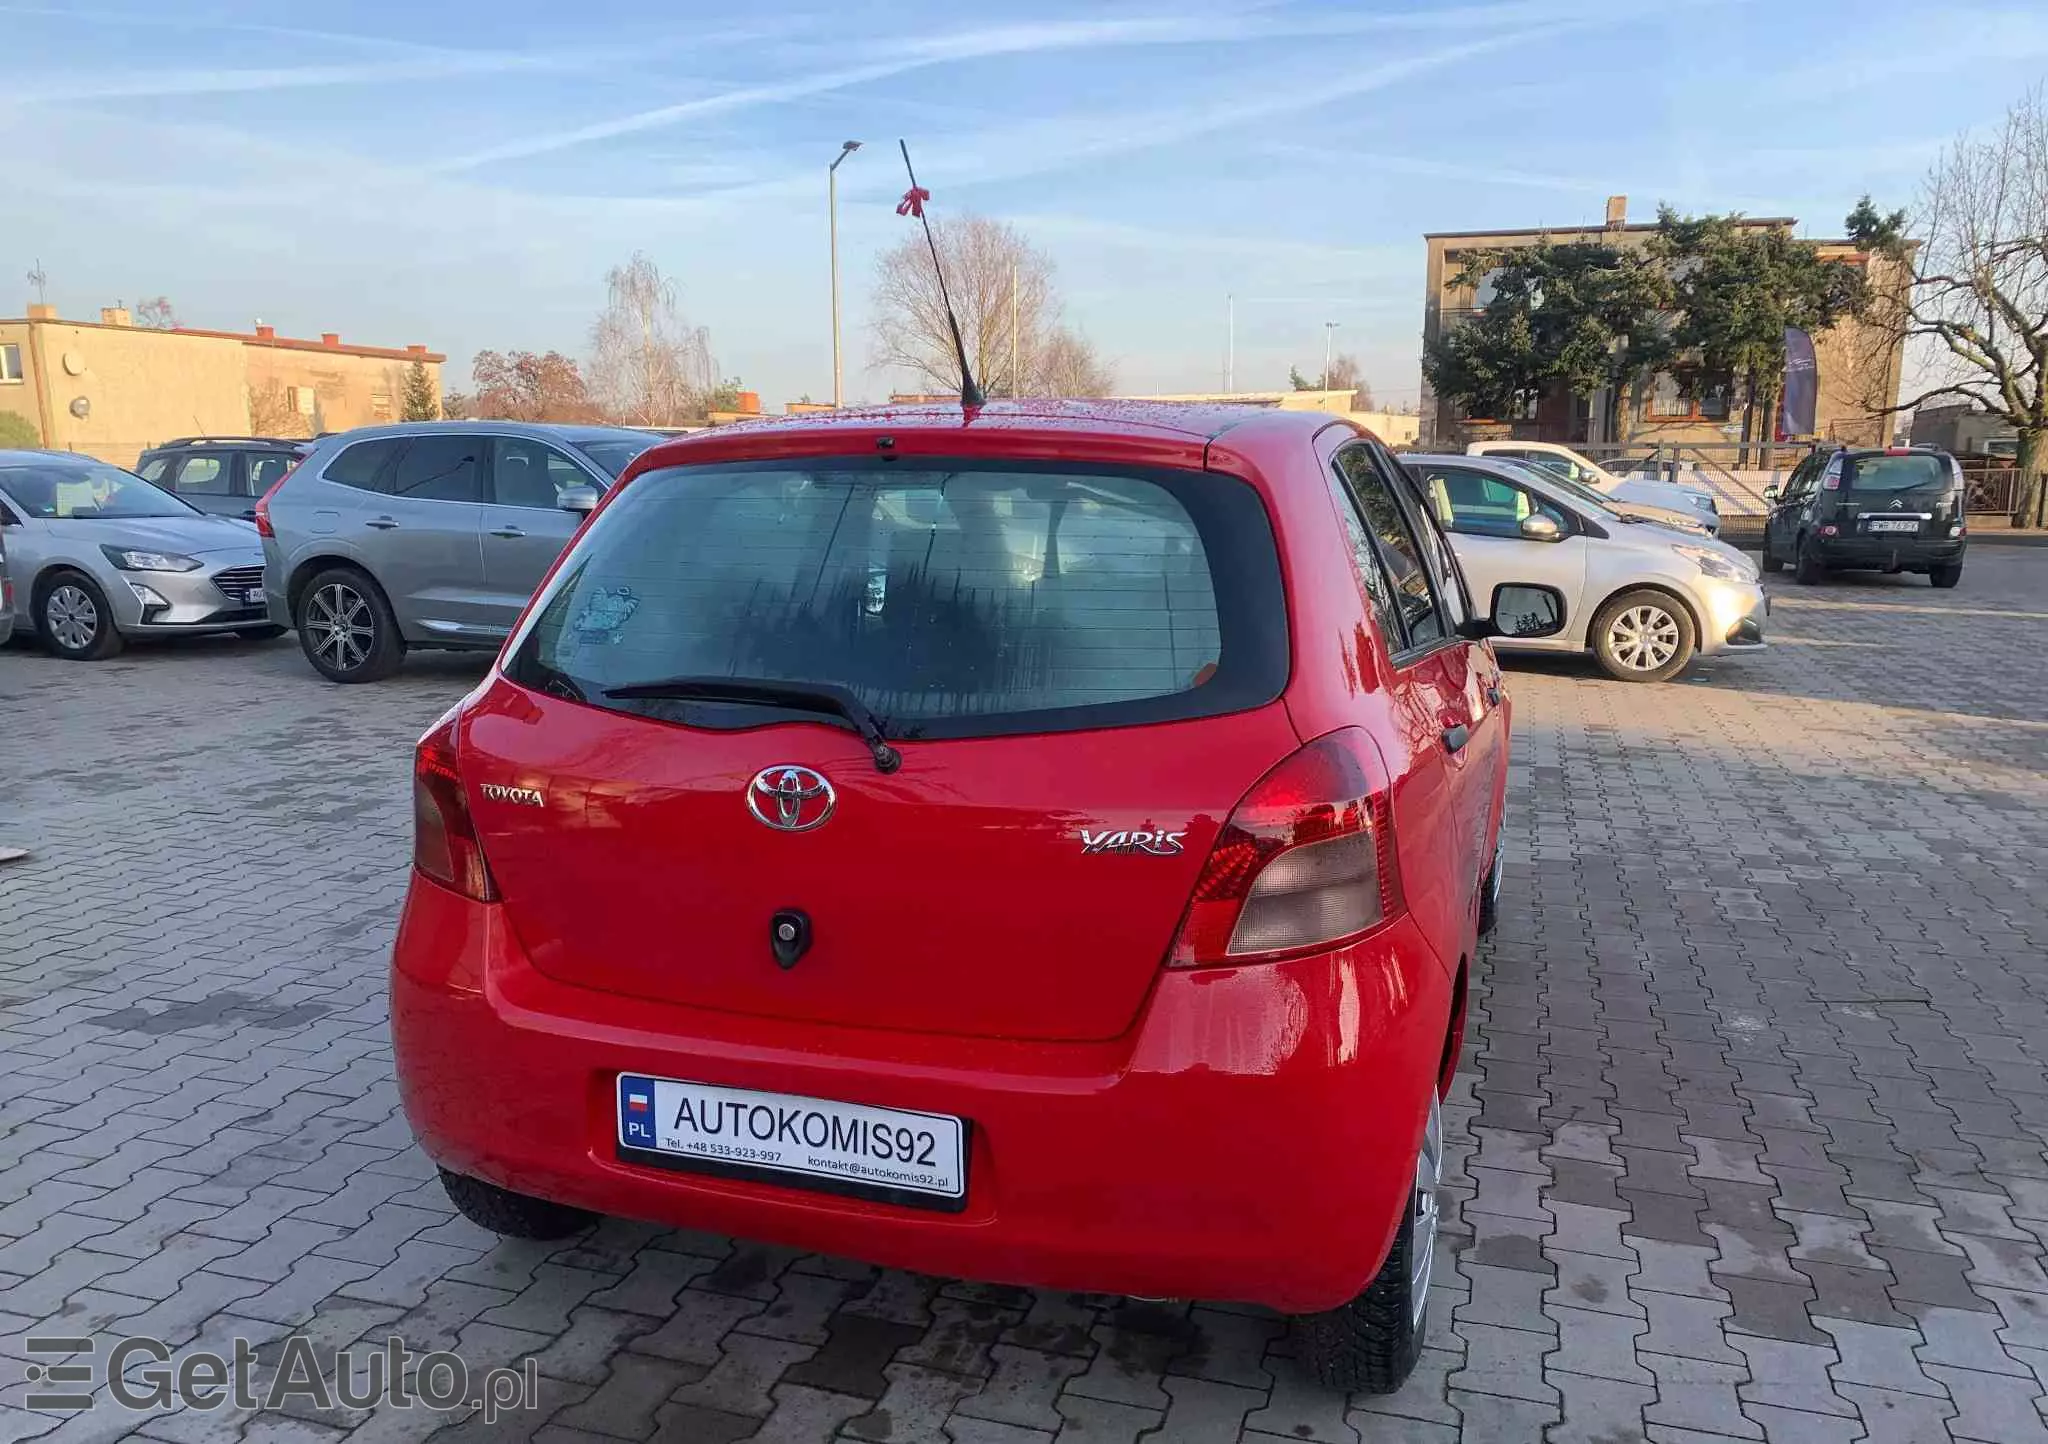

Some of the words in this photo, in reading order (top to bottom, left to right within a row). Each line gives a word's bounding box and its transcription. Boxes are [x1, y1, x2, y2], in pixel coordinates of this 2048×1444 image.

[480, 783, 545, 807] TOYOTA
[628, 1121, 651, 1139] PL
[674, 1096, 937, 1168] AUTOKOMIS92
[665, 1137, 684, 1149] Tel.
[686, 1142, 708, 1152] +48
[710, 1143, 782, 1162] 533-923-997
[807, 1155, 949, 1188] kontakt@autokomis92.pl
